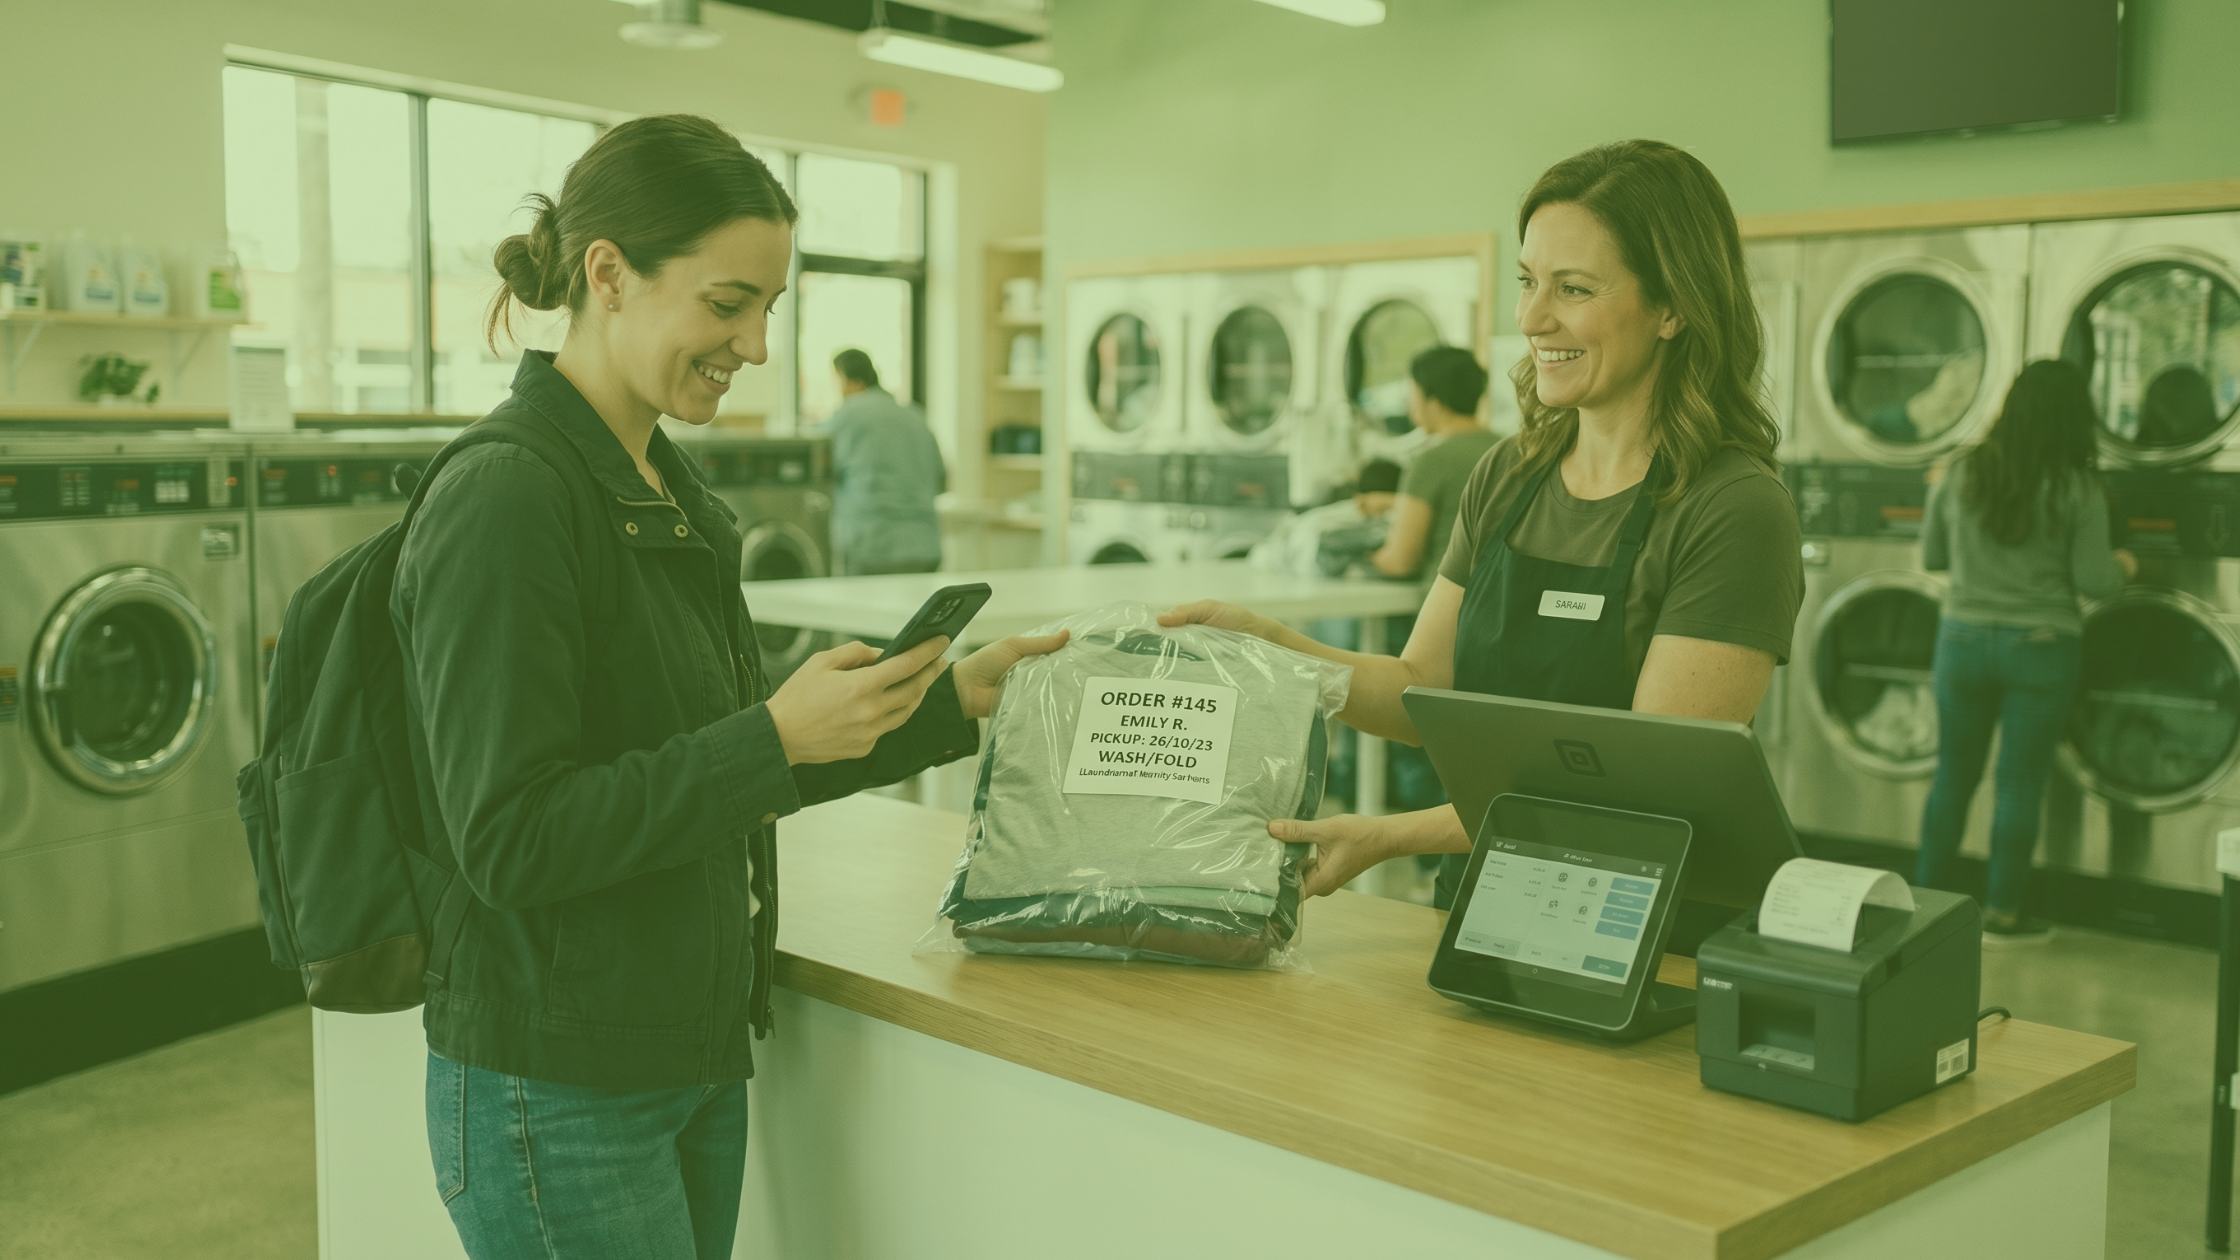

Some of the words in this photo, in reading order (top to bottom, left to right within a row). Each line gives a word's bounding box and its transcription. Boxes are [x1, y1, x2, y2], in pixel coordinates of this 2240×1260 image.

[1101, 691, 1165, 708] ORDER
[1171, 695, 1218, 713] #145
[1120, 715, 1169, 729] EMILY
[1172, 718, 1188, 731] R.
[1090, 732, 1145, 746] PICKUP:
[1149, 735, 1213, 751] 26/10/23
[1098, 750, 1197, 768] WASH/FOLD
